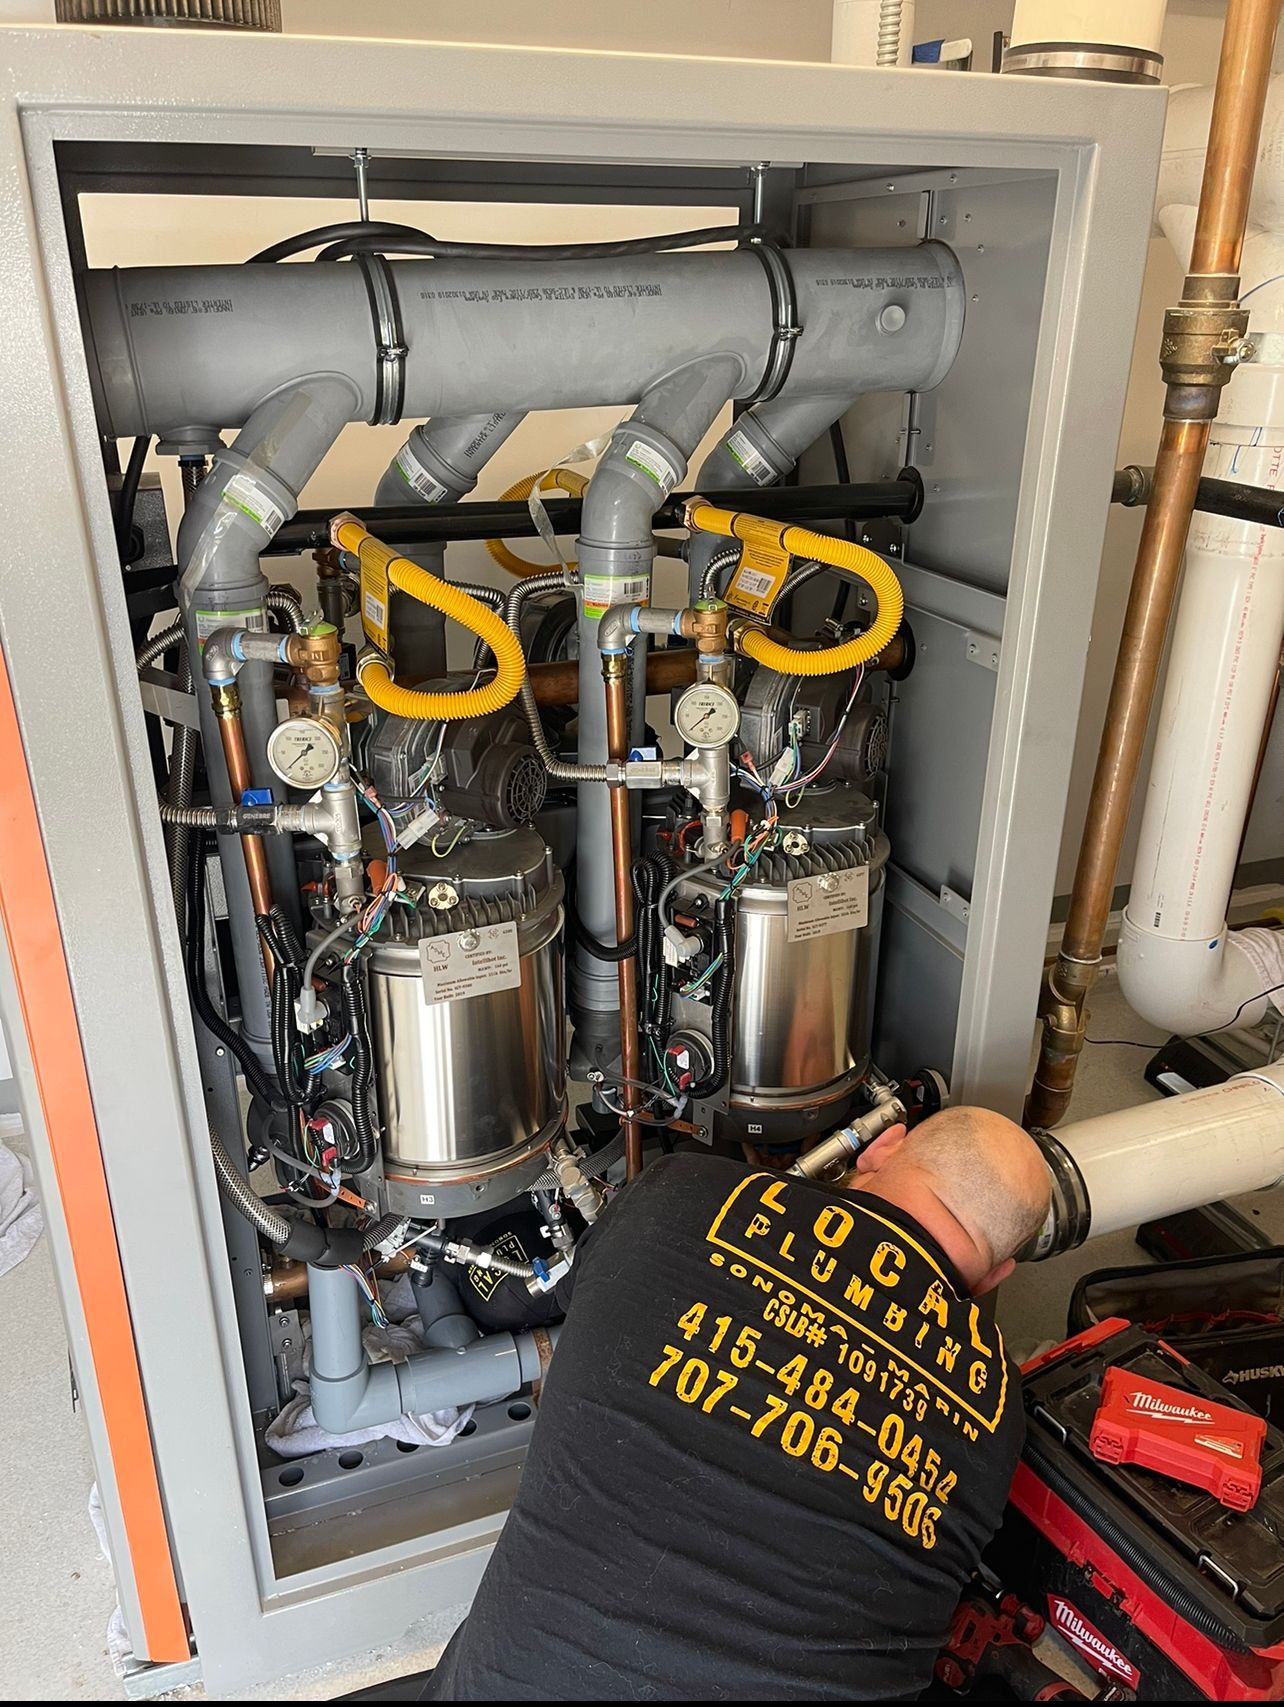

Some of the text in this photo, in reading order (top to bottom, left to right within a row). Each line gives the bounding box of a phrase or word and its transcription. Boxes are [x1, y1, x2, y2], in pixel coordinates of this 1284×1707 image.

[433, 964, 448, 972] HLW
[709, 1252, 848, 1341] SONOMA
[887, 1358, 979, 1442] MARIN
[745, 1213, 988, 1395] PLUMBING
[760, 1181, 992, 1358] LOCAL
[648, 1344, 943, 1550] 707-706-9506
[677, 1302, 958, 1504] 415-484-0454
[763, 1299, 928, 1422] CSLB# 1091739
[1129, 1391, 1213, 1421] Milwaukee
[1054, 1600, 1133, 1676] Milwaukee
